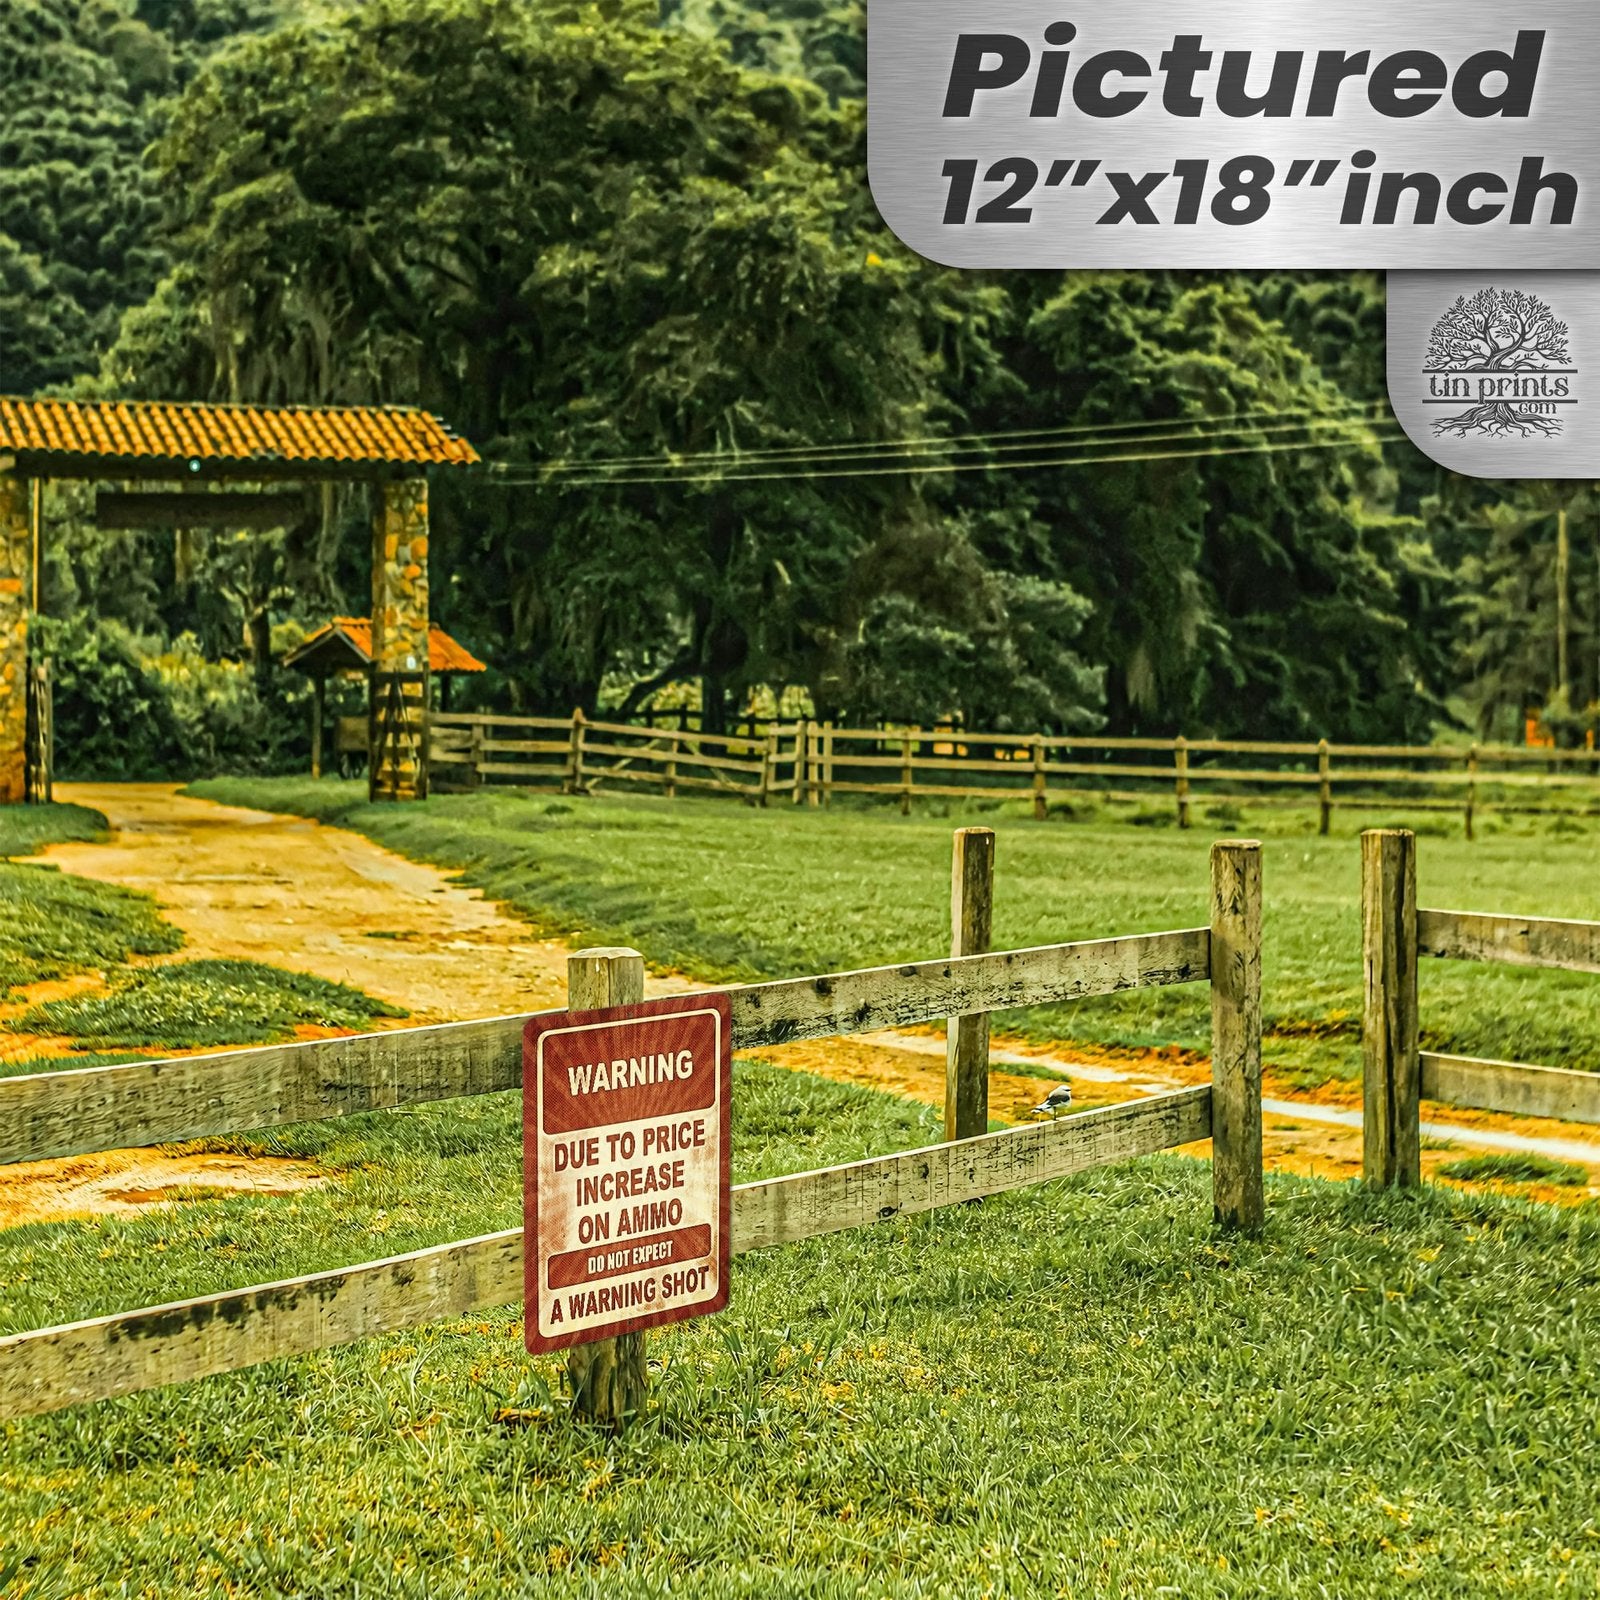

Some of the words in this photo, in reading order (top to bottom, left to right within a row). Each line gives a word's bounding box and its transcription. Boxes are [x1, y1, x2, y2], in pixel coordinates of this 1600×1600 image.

[567, 1049, 693, 1096] WARNING
[554, 1137, 599, 1173] DUE
[606, 1130, 635, 1163] TO
[643, 1119, 705, 1157] PRICE
[576, 1160, 685, 1207] INCREASE
[578, 1211, 610, 1245] ON
[617, 1198, 683, 1238] AMMO
[587, 1251, 605, 1274] DO
[607, 1246, 631, 1270] NOT
[632, 1240, 673, 1265] EXPECT
[550, 1297, 564, 1325] A
[568, 1276, 656, 1320] WARNING
[662, 1265, 710, 1300] SHOT
